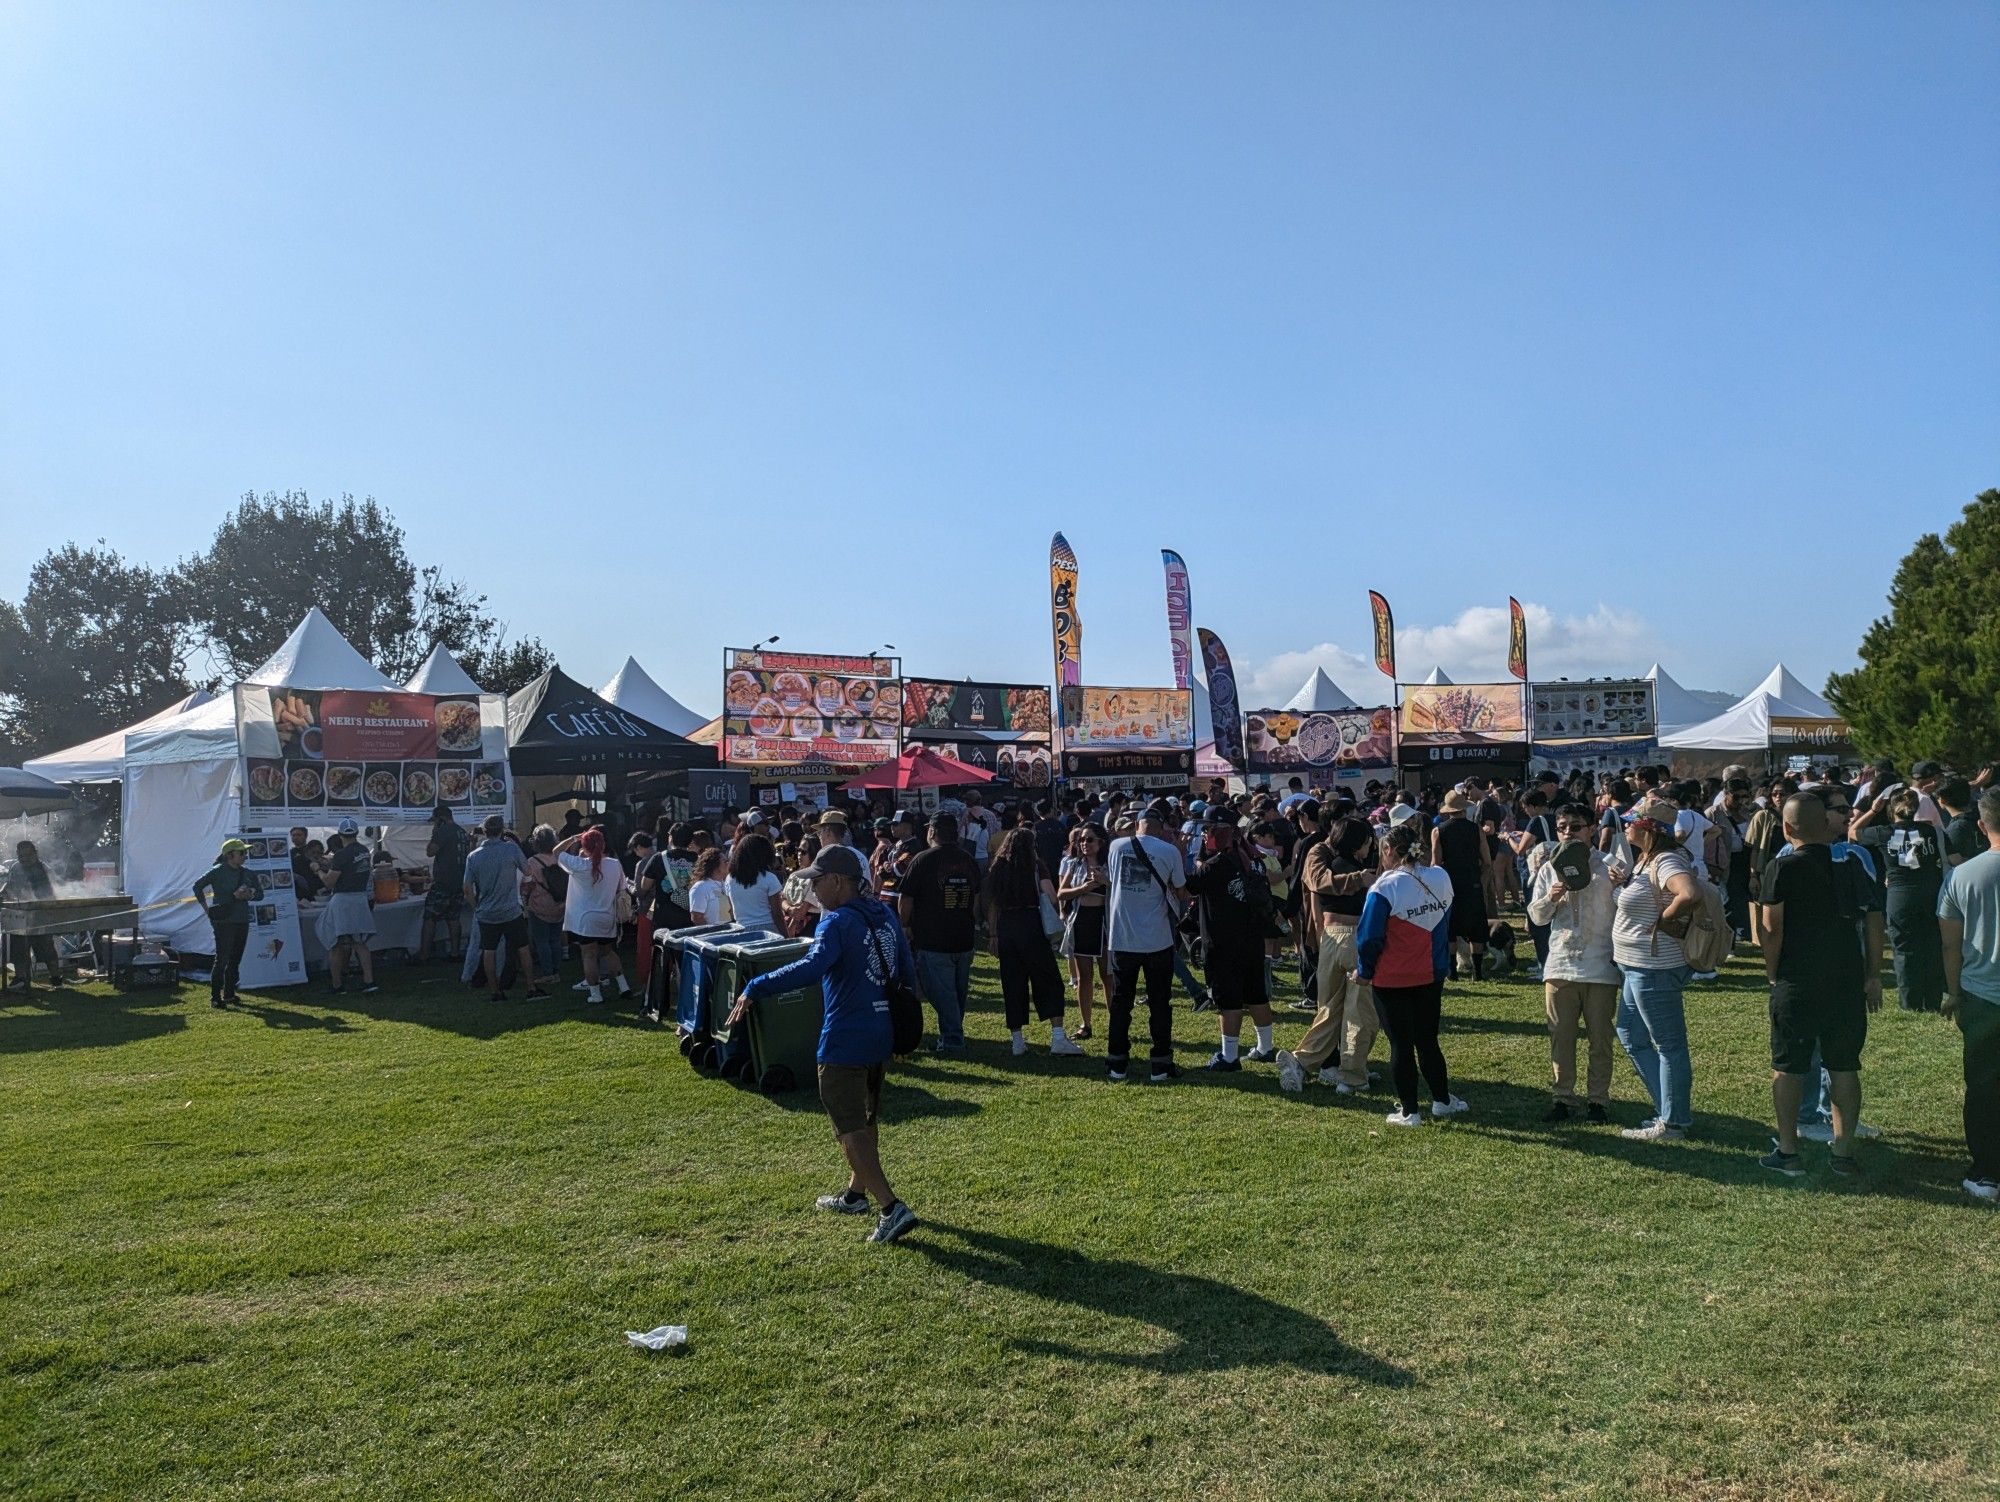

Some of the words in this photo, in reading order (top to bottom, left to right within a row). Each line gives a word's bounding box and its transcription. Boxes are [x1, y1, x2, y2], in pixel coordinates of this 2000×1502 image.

[328, 716, 362, 726] NERI'S
[364, 718, 430, 728] RESTAURANT
[547, 708, 618, 737] CAFÉ
[605, 710, 648, 737] 86
[1793, 725, 1840, 746] Waffle
[581, 753, 607, 762] UBE
[618, 752, 662, 760] NERDS
[1456, 747, 1501, 759] @TATAY_RY
[1097, 756, 1123, 768] TIM'S
[765, 765, 832, 777] EMPANADAS
[1151, 776, 1164, 785] MILK
[1166, 775, 1185, 784] SHAKES
[705, 783, 725, 801] CAFÉ
[727, 784, 737, 801] 86
